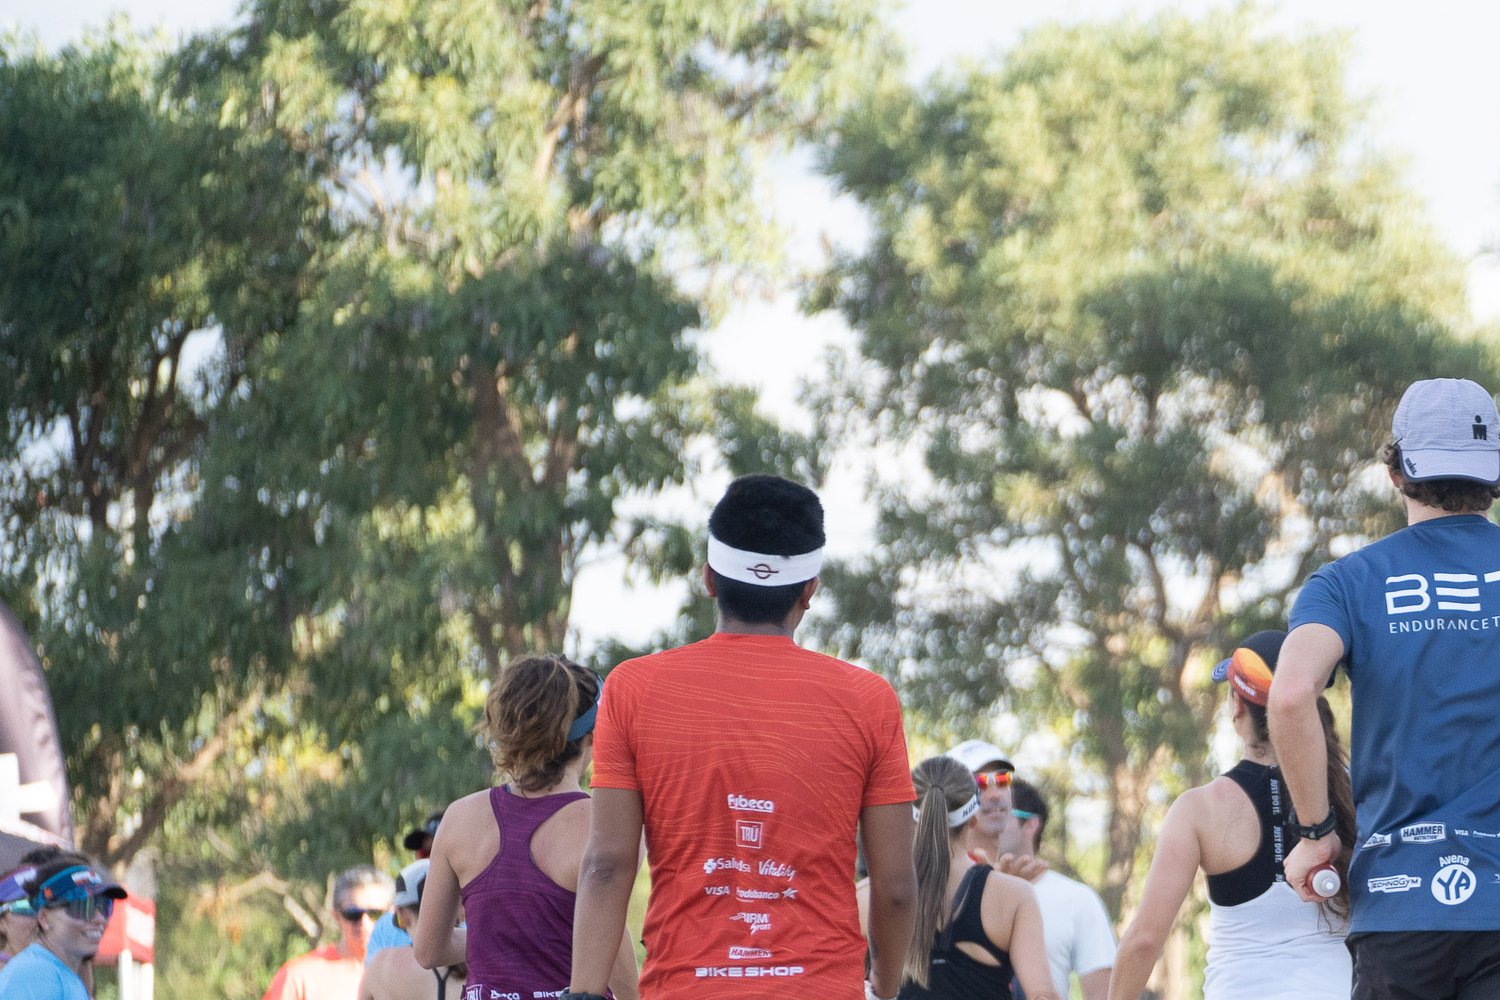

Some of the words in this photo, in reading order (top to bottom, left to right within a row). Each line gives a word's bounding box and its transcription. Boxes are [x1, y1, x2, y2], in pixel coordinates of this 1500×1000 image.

[1270, 779, 1279, 795] JUST
[1272, 795, 1281, 806] DO
[1273, 826, 1283, 842] JUST
[1403, 826, 1443, 837] HAMMER
[1275, 843, 1284, 853] DO
[1439, 855, 1470, 867] Avena
[704, 886, 730, 896] VISA
